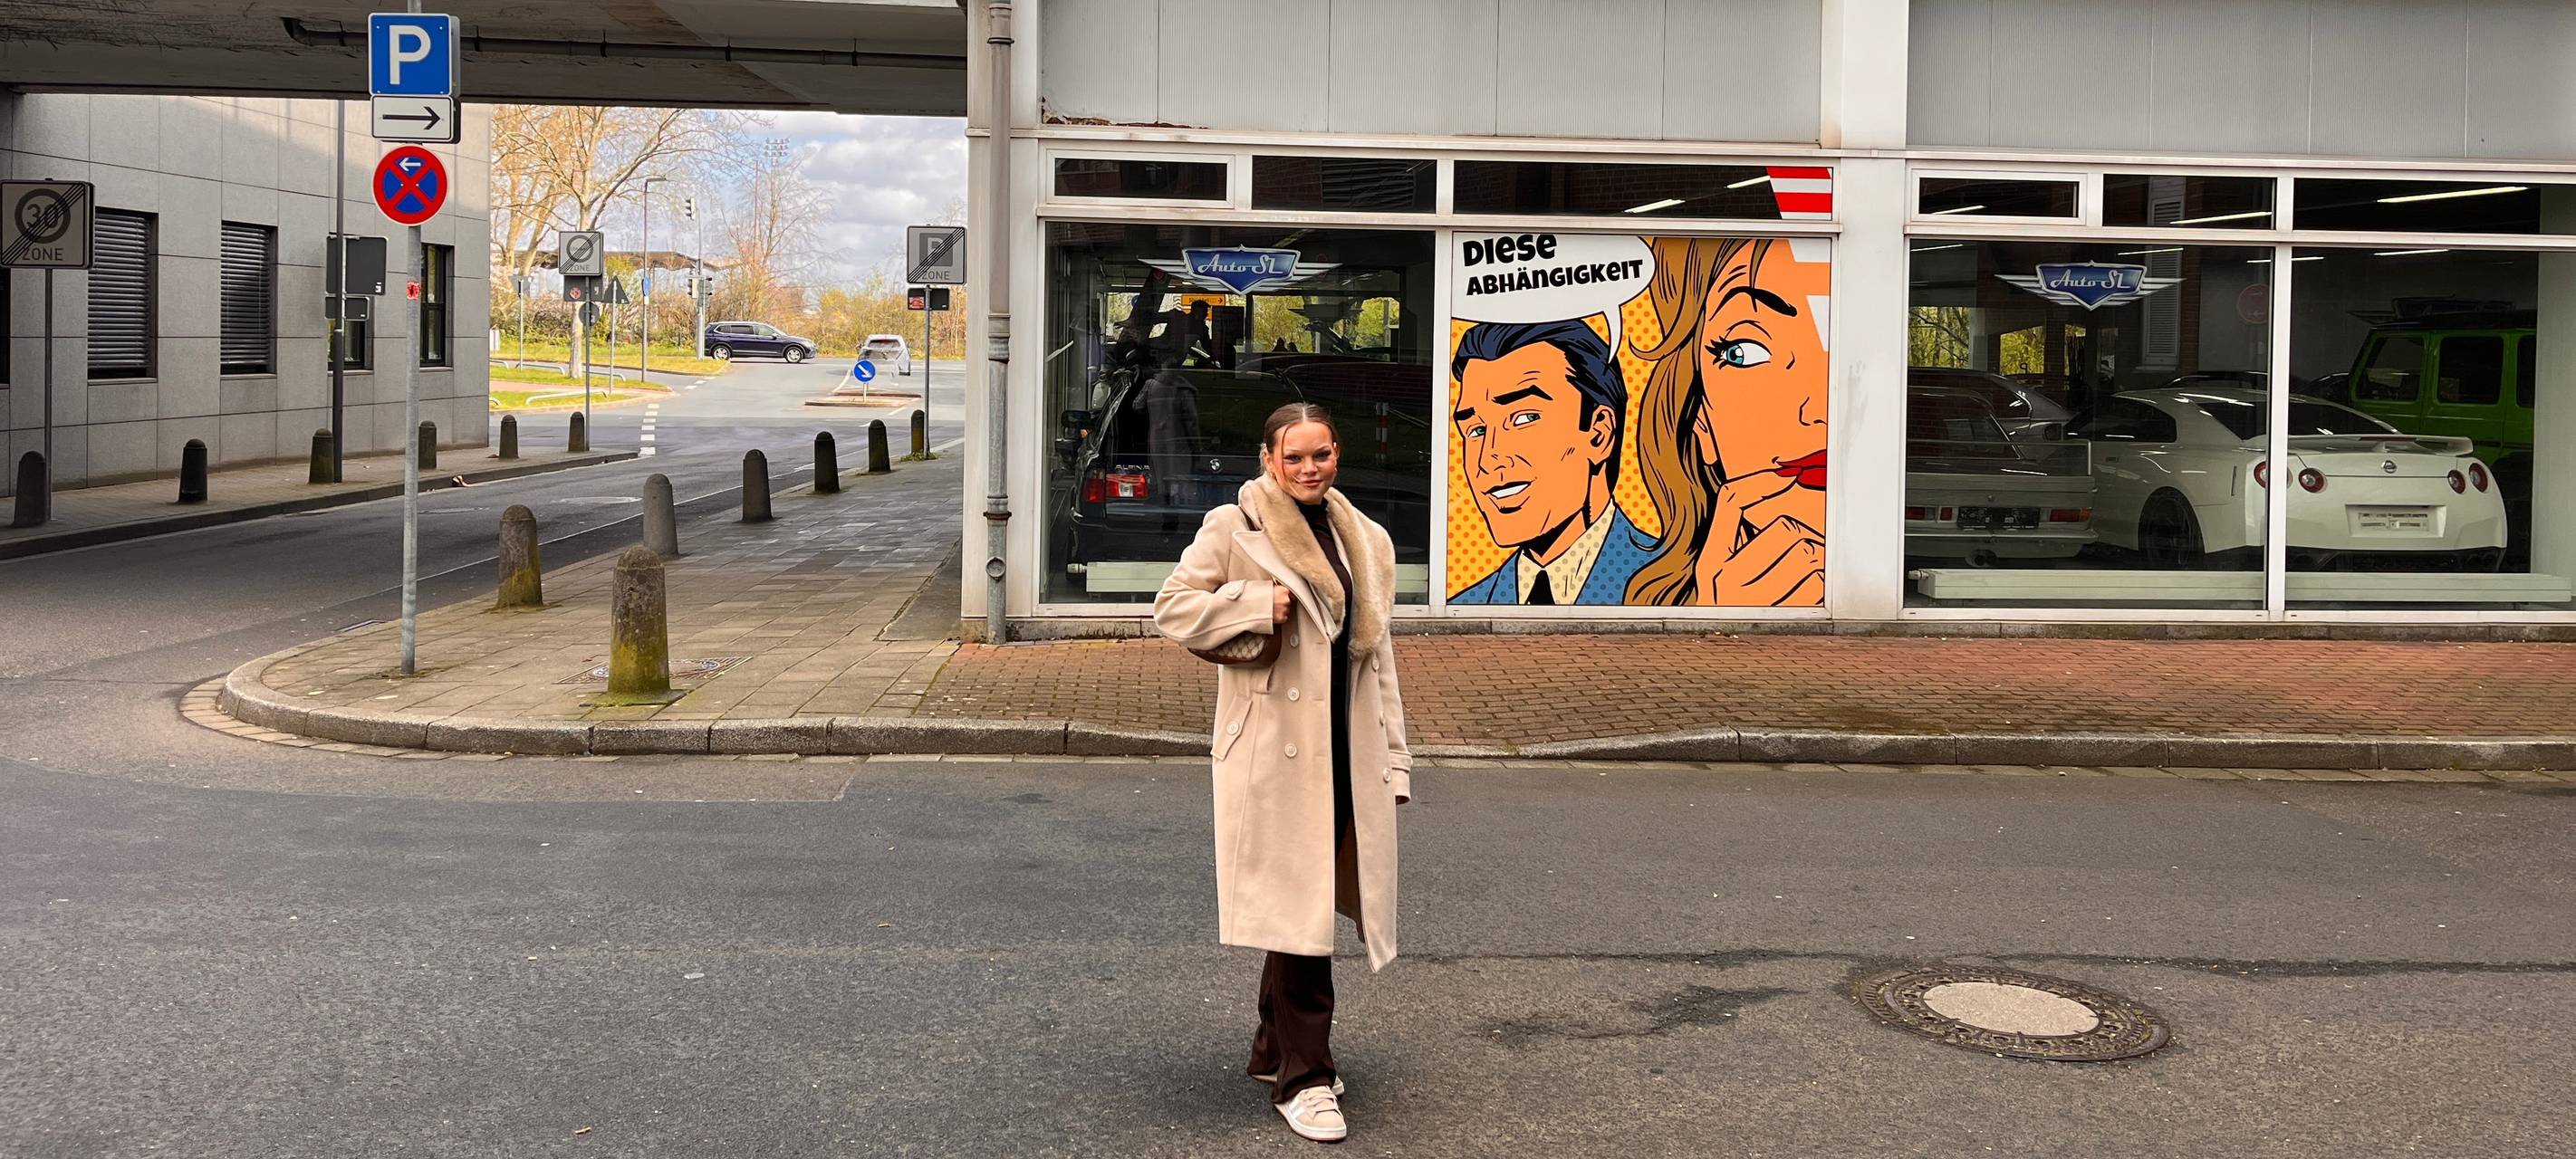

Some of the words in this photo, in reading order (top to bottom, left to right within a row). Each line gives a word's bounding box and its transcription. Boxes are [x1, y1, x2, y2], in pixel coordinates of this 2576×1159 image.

[389, 24, 431, 85] P
[22, 247, 63, 261] ZONE
[1197, 254, 1246, 273] Auto
[1251, 254, 1283, 273] SL
[922, 271, 950, 280] ZONE
[2050, 269, 2096, 288] Auto
[2100, 270, 2130, 288] SL
